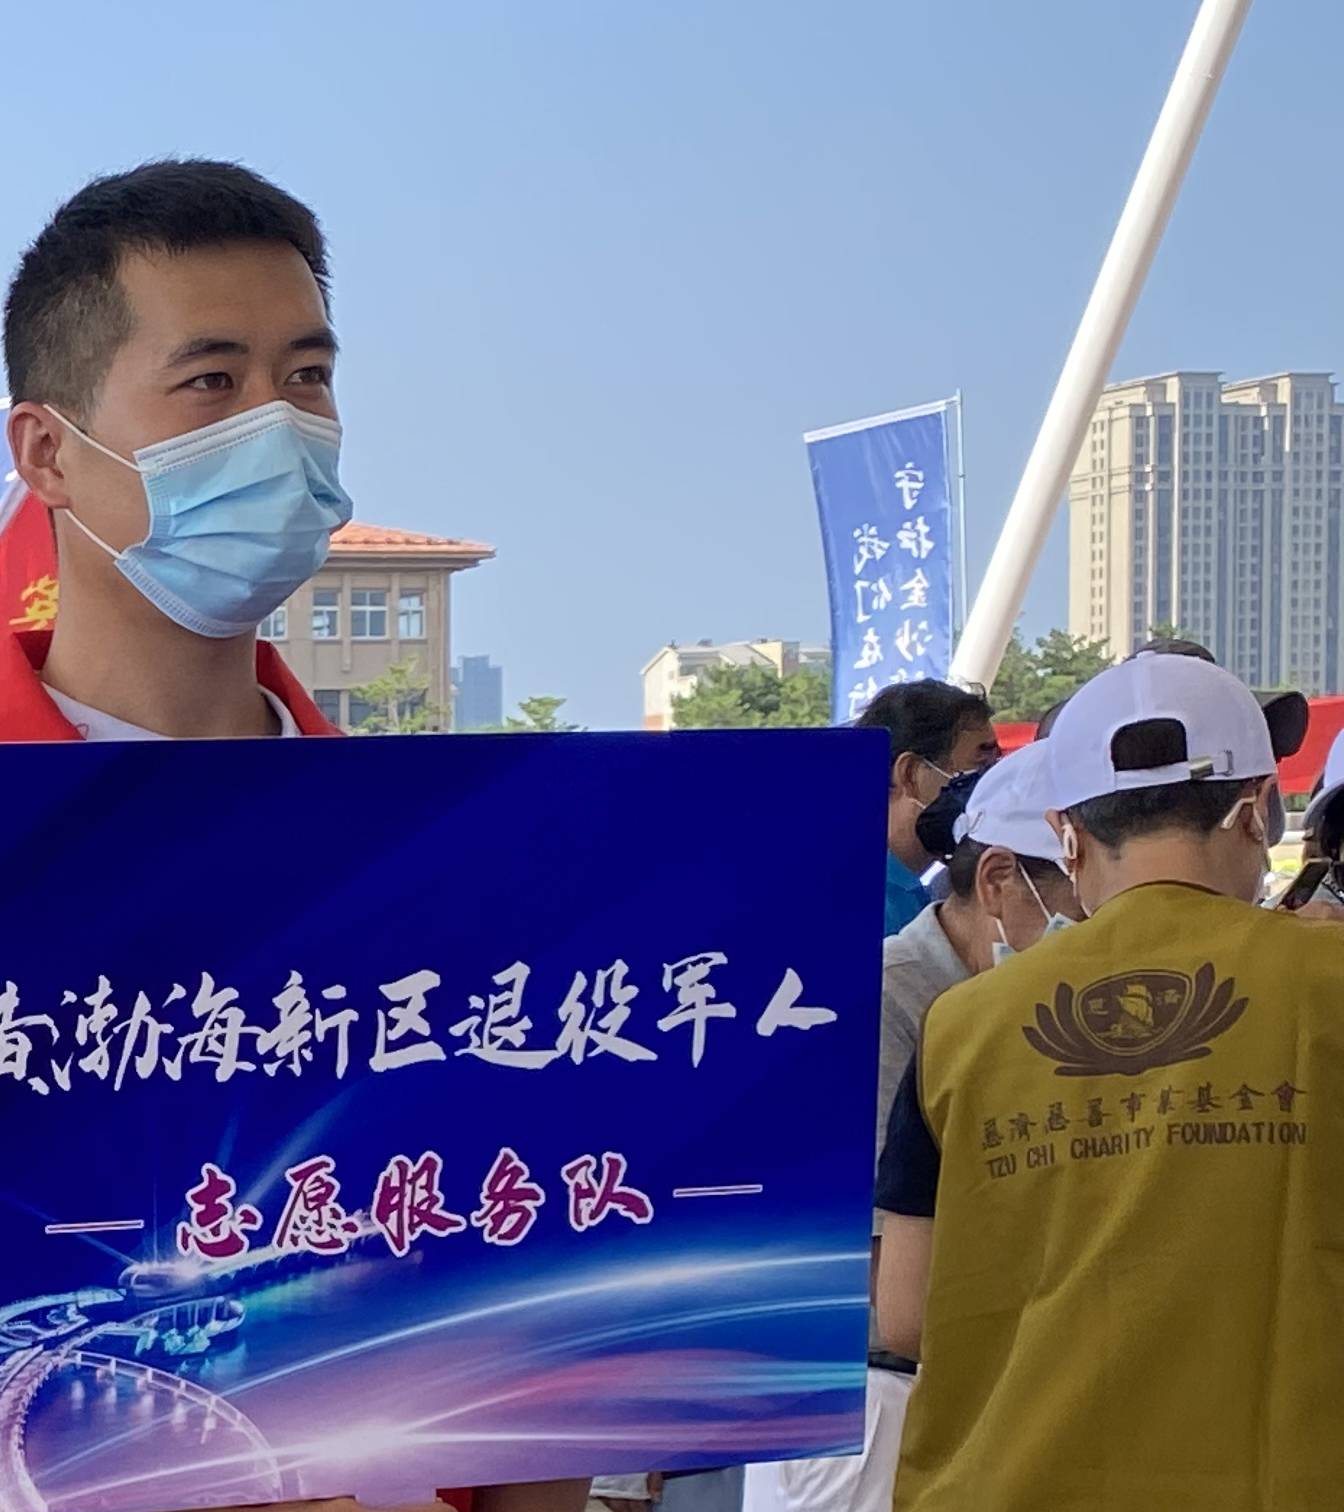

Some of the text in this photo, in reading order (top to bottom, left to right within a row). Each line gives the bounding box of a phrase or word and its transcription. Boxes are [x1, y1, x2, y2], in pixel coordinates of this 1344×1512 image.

[985, 1121, 1308, 1180] TZU CHI CHARITY FOUNDATION
[176, 1149, 653, 1260] 志愿服务队
